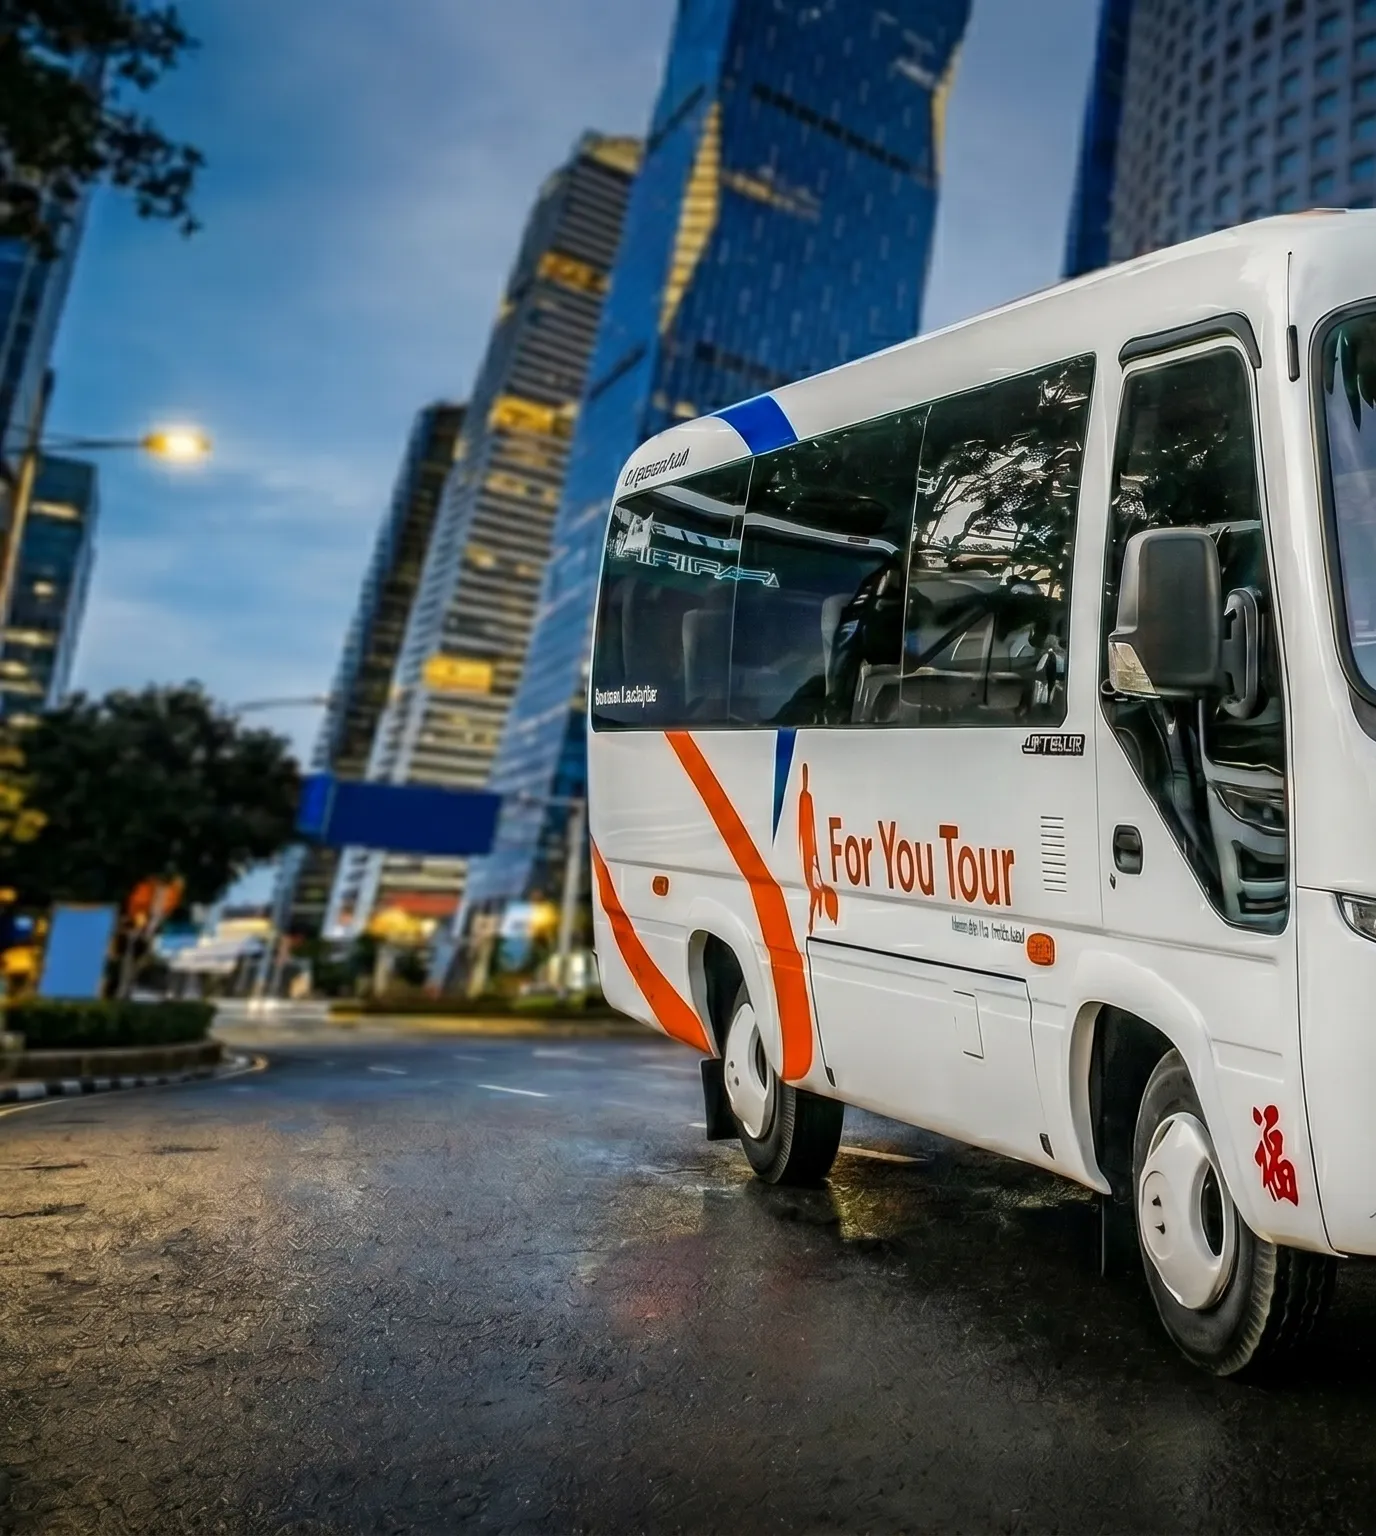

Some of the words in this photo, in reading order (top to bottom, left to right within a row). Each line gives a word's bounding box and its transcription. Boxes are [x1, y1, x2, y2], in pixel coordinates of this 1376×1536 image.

[828, 816, 873, 888] For
[877, 820, 935, 897] You
[939, 824, 1015, 907] Tour
[1252, 1104, 1299, 1207] 福
